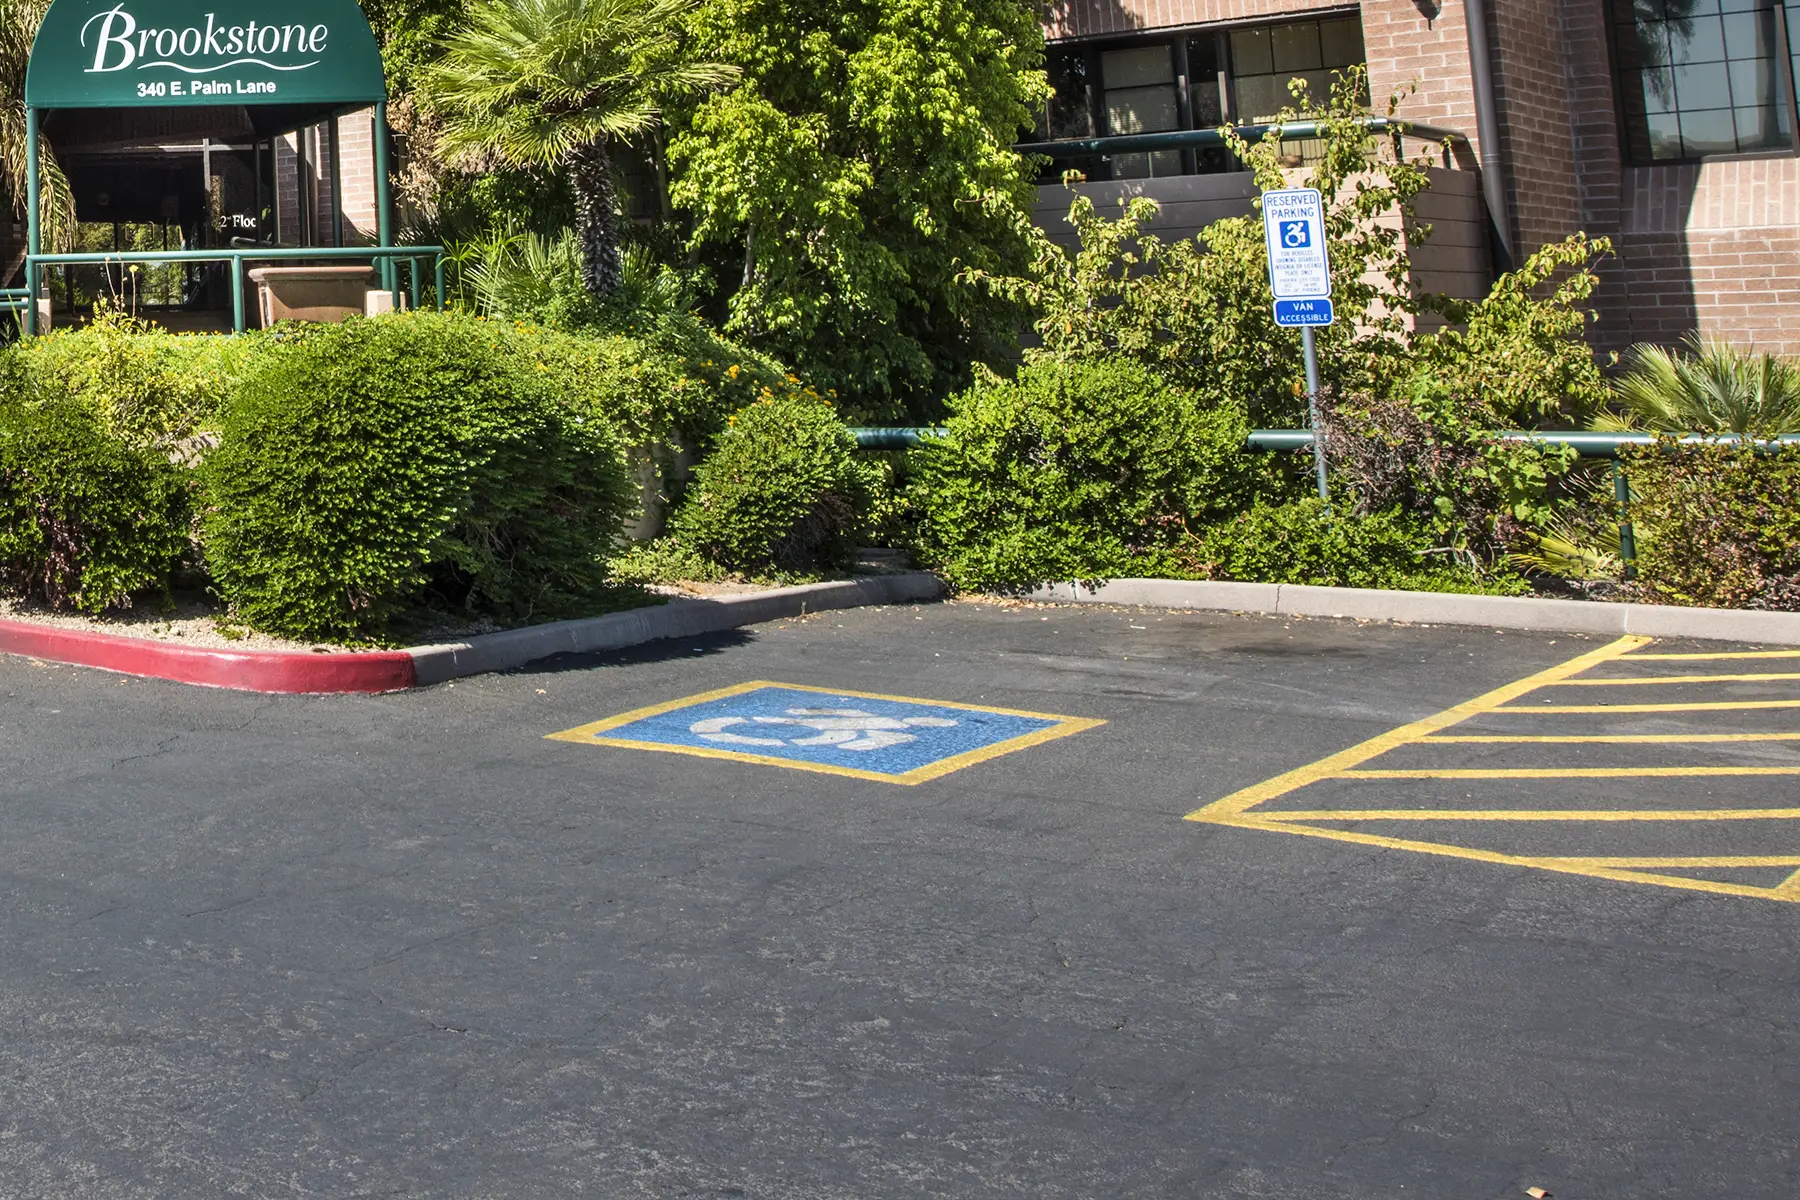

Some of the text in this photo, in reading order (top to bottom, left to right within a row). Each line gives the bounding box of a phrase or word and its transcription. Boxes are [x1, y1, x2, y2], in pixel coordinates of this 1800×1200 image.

[80, 2, 328, 73] Brookstone
[137, 79, 276, 97] 340 E. Palm Lane
[1266, 194, 1316, 207] RESERVED
[1271, 207, 1314, 218] PARKING
[232, 214, 256, 227] Floo
[1293, 302, 1313, 311] VAN
[1280, 313, 1328, 322] ACCESSIBLE
